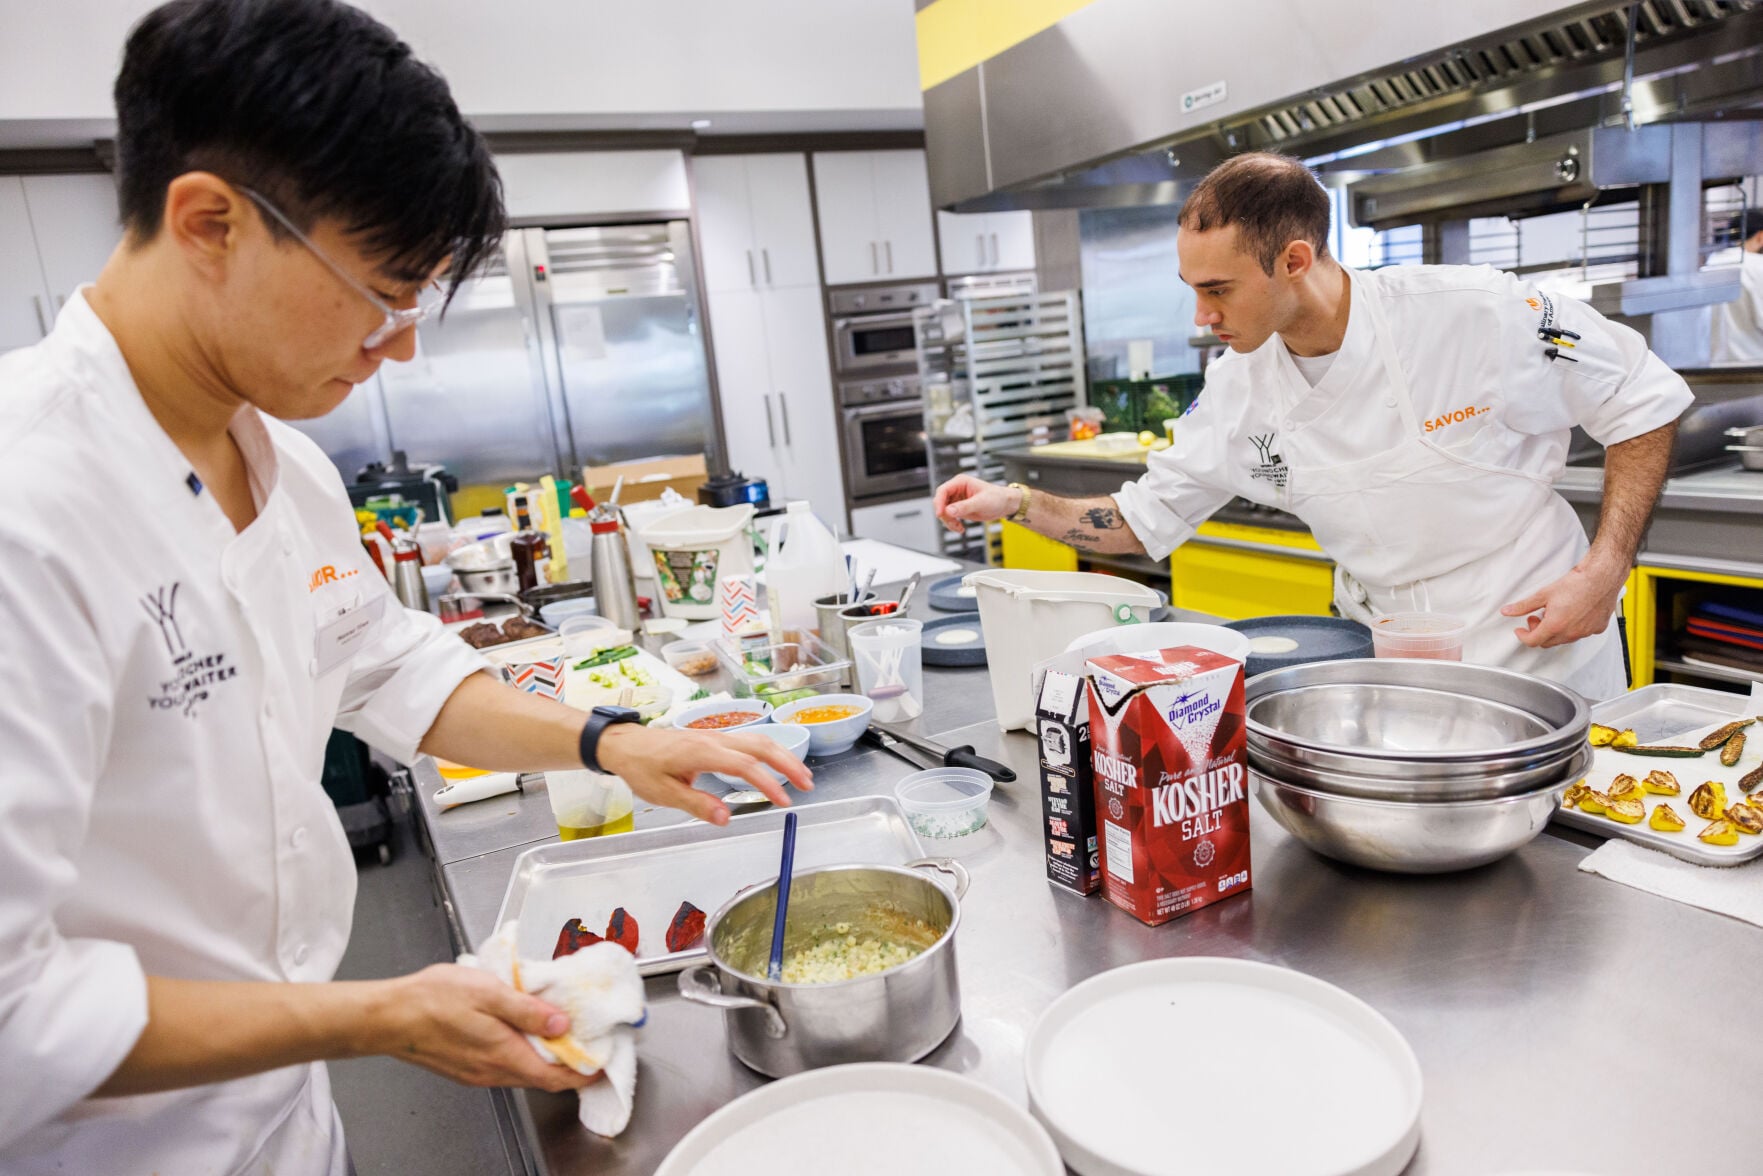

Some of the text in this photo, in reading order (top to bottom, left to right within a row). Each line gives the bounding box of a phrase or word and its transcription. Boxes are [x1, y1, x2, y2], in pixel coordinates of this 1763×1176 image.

[1424, 405, 1490, 433] SAVOR...
[1168, 693, 1209, 723] Diamond
[1187, 698, 1221, 725] Crystal
[1093, 749, 1138, 790] KOSHER
[1104, 777, 1125, 797] SALT
[1151, 762, 1245, 828] KOSHER
[1181, 809, 1223, 842] SALT
